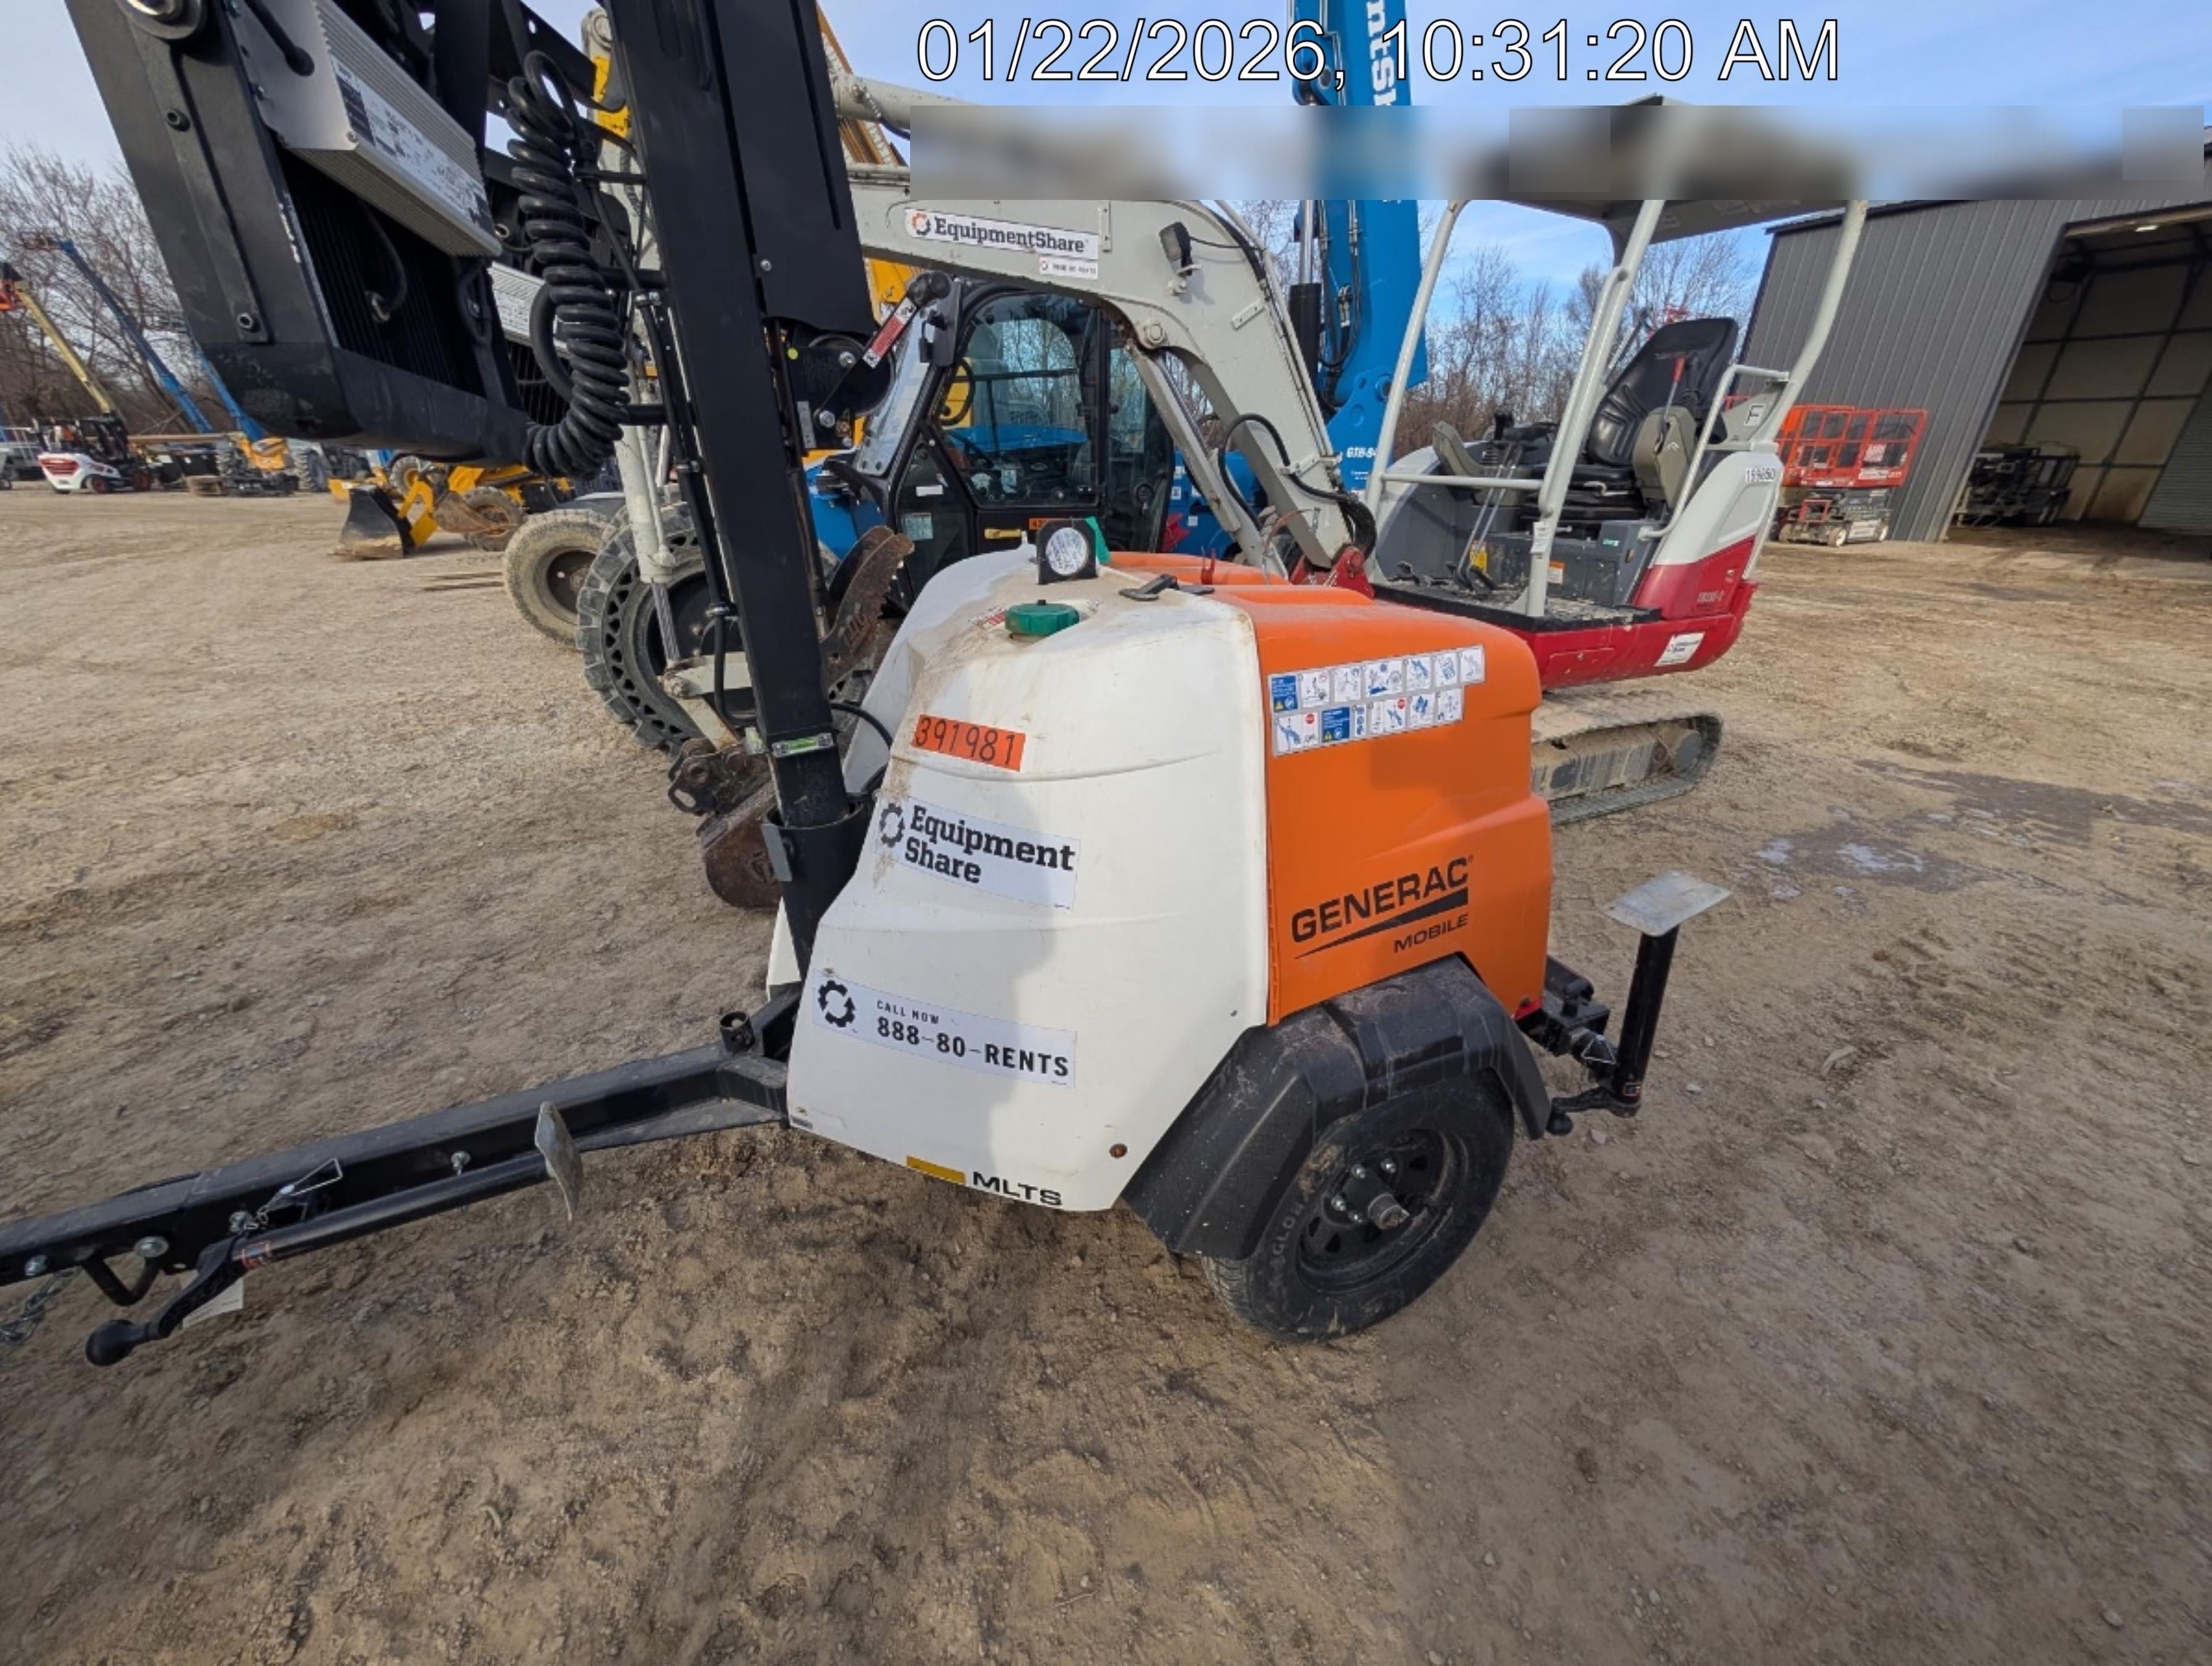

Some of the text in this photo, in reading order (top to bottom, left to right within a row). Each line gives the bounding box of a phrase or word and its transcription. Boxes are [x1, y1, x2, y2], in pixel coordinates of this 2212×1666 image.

[934, 215, 1084, 253] EquipmentShare
[1745, 405, 1764, 425] F
[916, 718, 1014, 765] 391981
[905, 836, 982, 884] Share
[910, 805, 1076, 871] Equipment
[1291, 856, 1468, 943] GENERAC
[1393, 913, 1468, 953] MOBILE
[877, 999, 939, 1024] CALL NOW
[877, 1016, 1069, 1077] 888-80-RENTS
